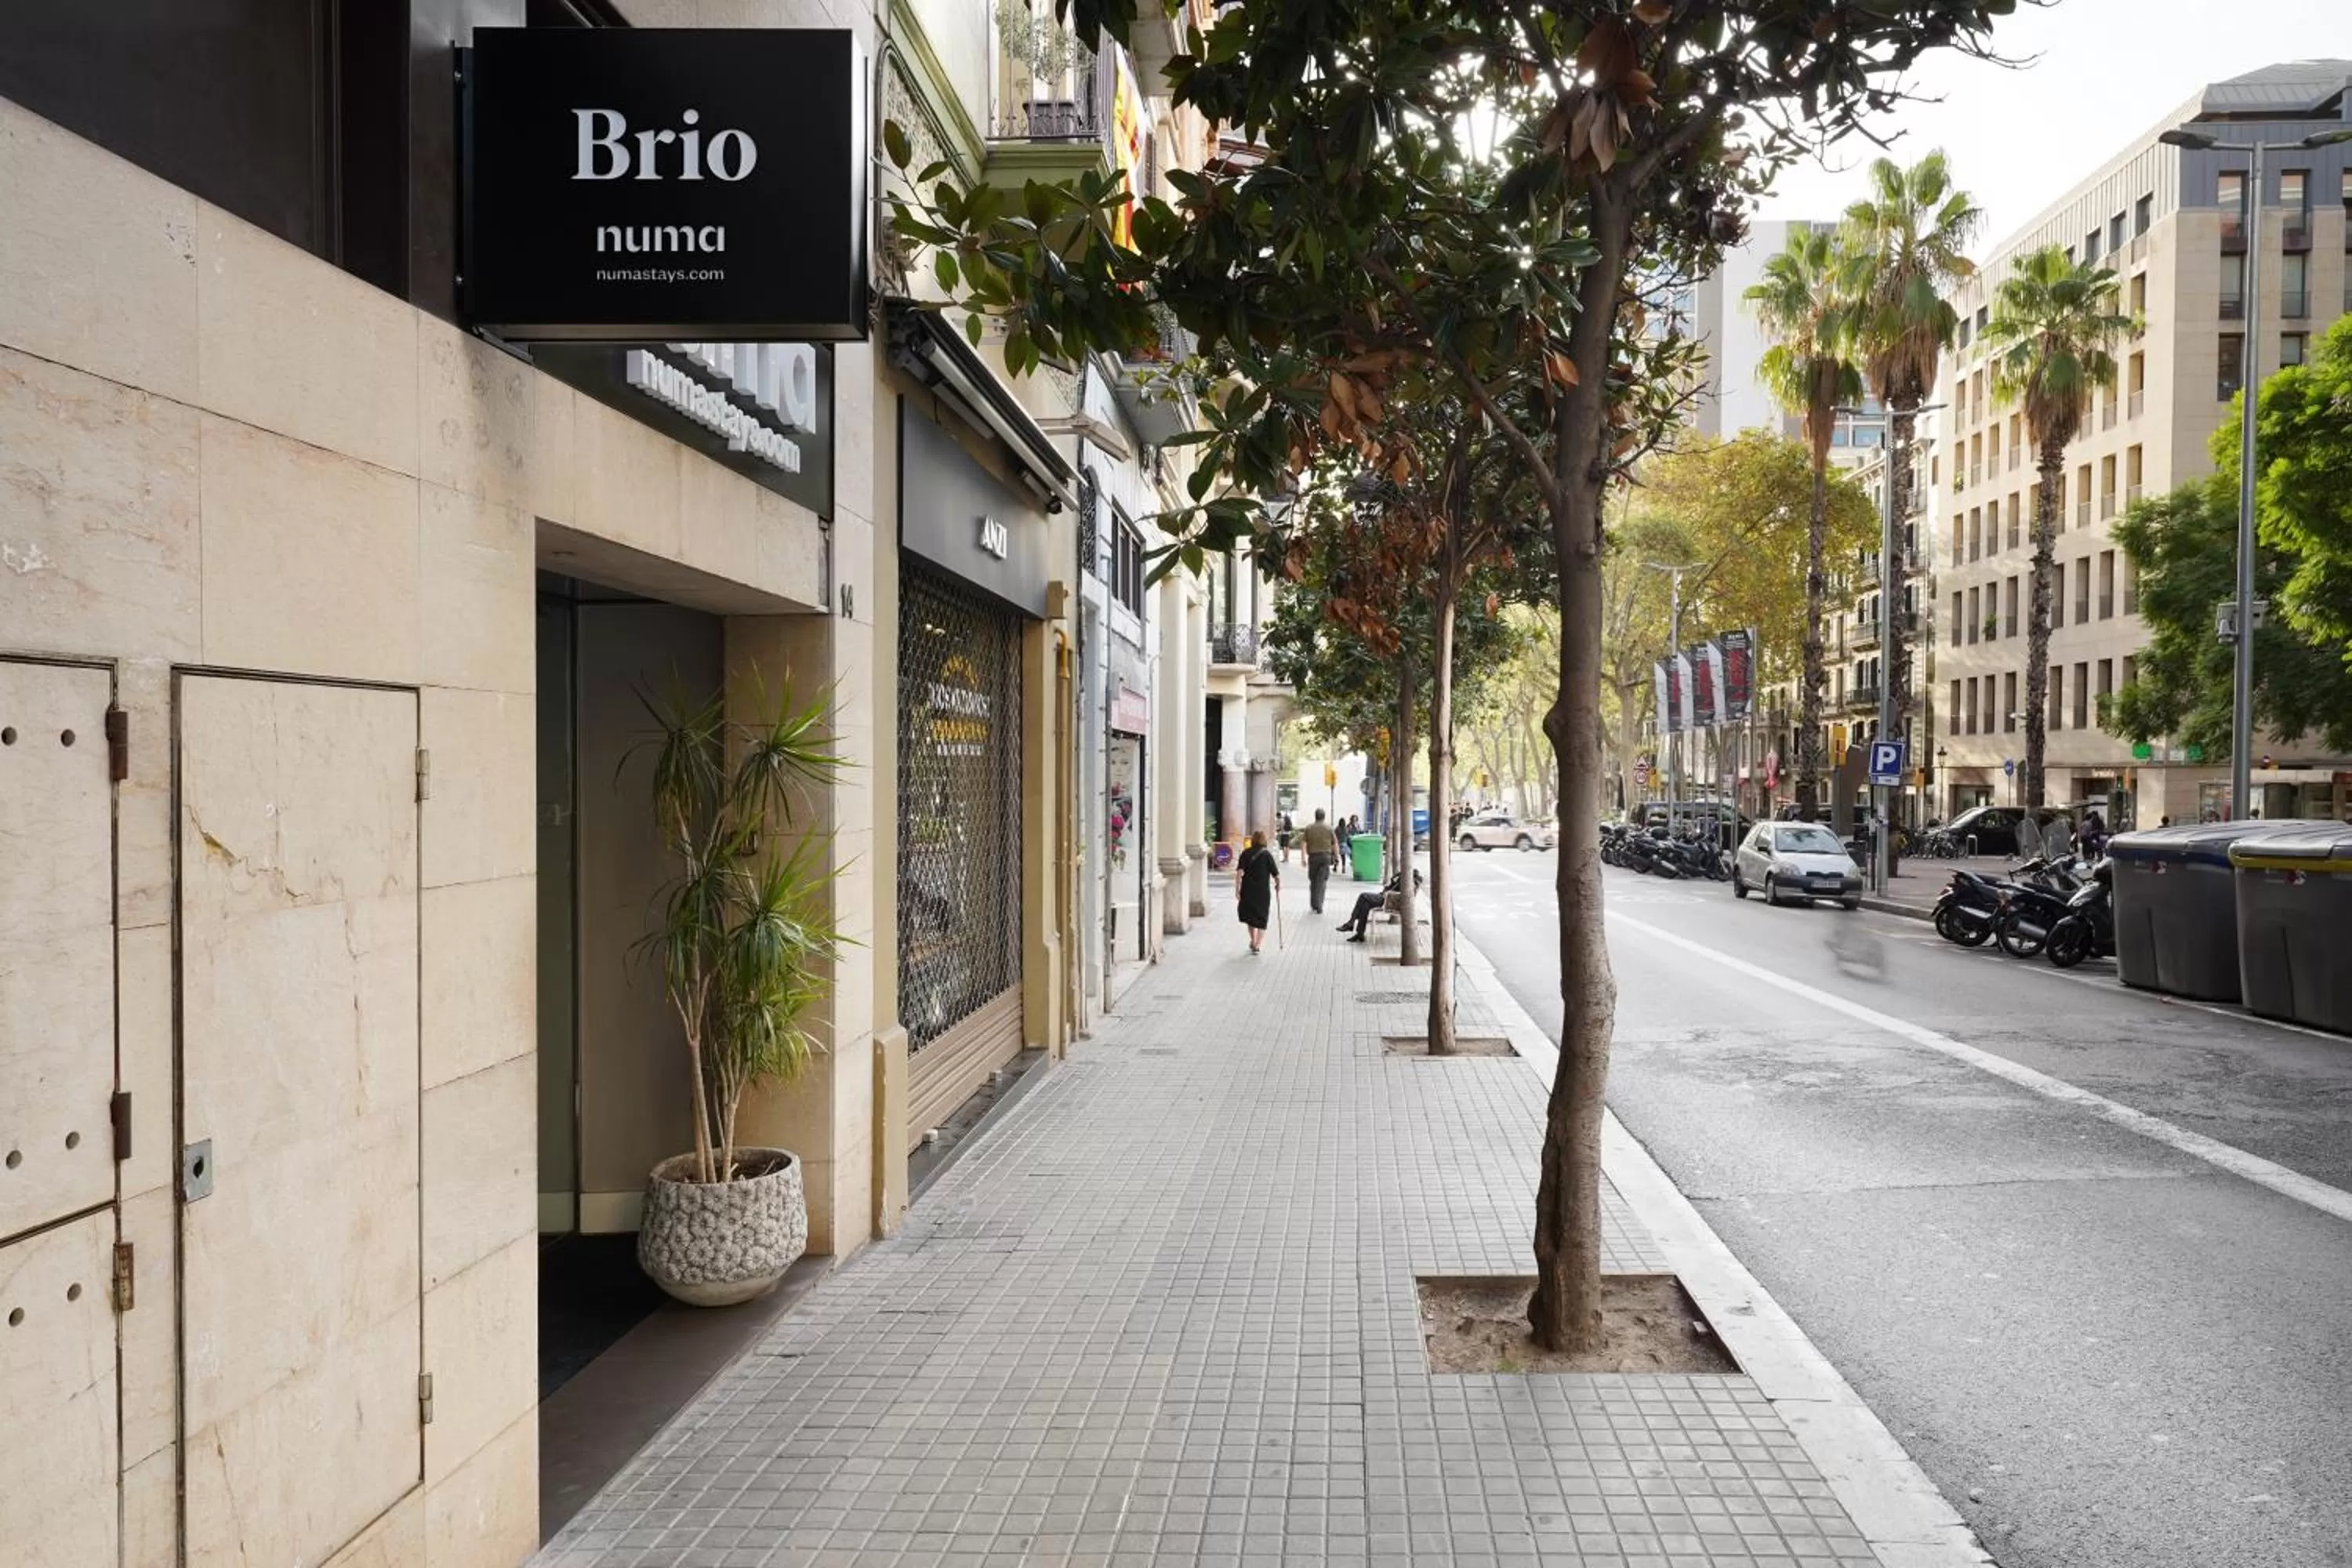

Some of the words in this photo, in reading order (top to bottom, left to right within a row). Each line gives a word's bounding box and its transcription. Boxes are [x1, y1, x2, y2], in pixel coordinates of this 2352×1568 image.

[571, 108, 757, 182] Brio
[597, 225, 725, 252] numa
[597, 268, 724, 283] numastays.com
[980, 516, 1007, 559] ANZI
[1876, 746, 1896, 771] P
